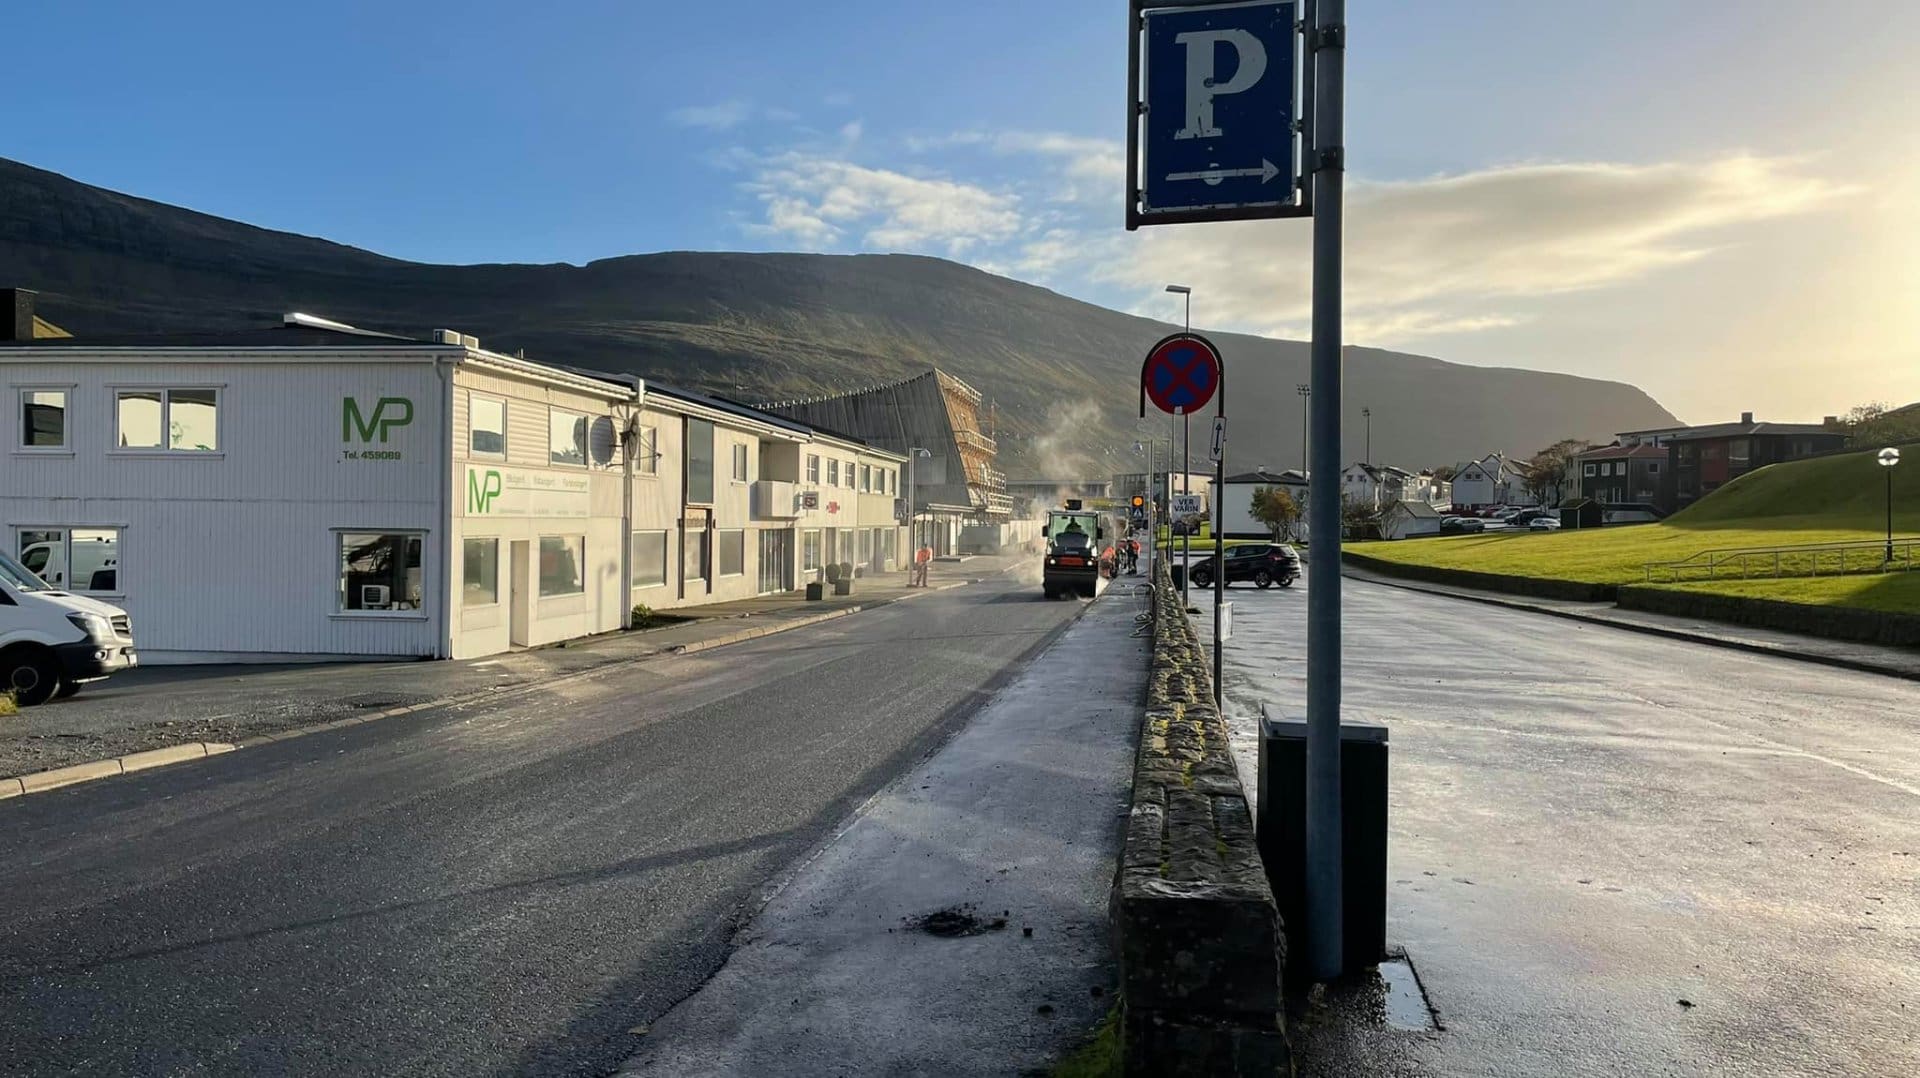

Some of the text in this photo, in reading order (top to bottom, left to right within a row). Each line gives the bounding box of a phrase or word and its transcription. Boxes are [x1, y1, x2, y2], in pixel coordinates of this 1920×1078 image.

[1174, 28, 1268, 140] P
[343, 396, 414, 443] MP
[468, 468, 501, 514] MP
